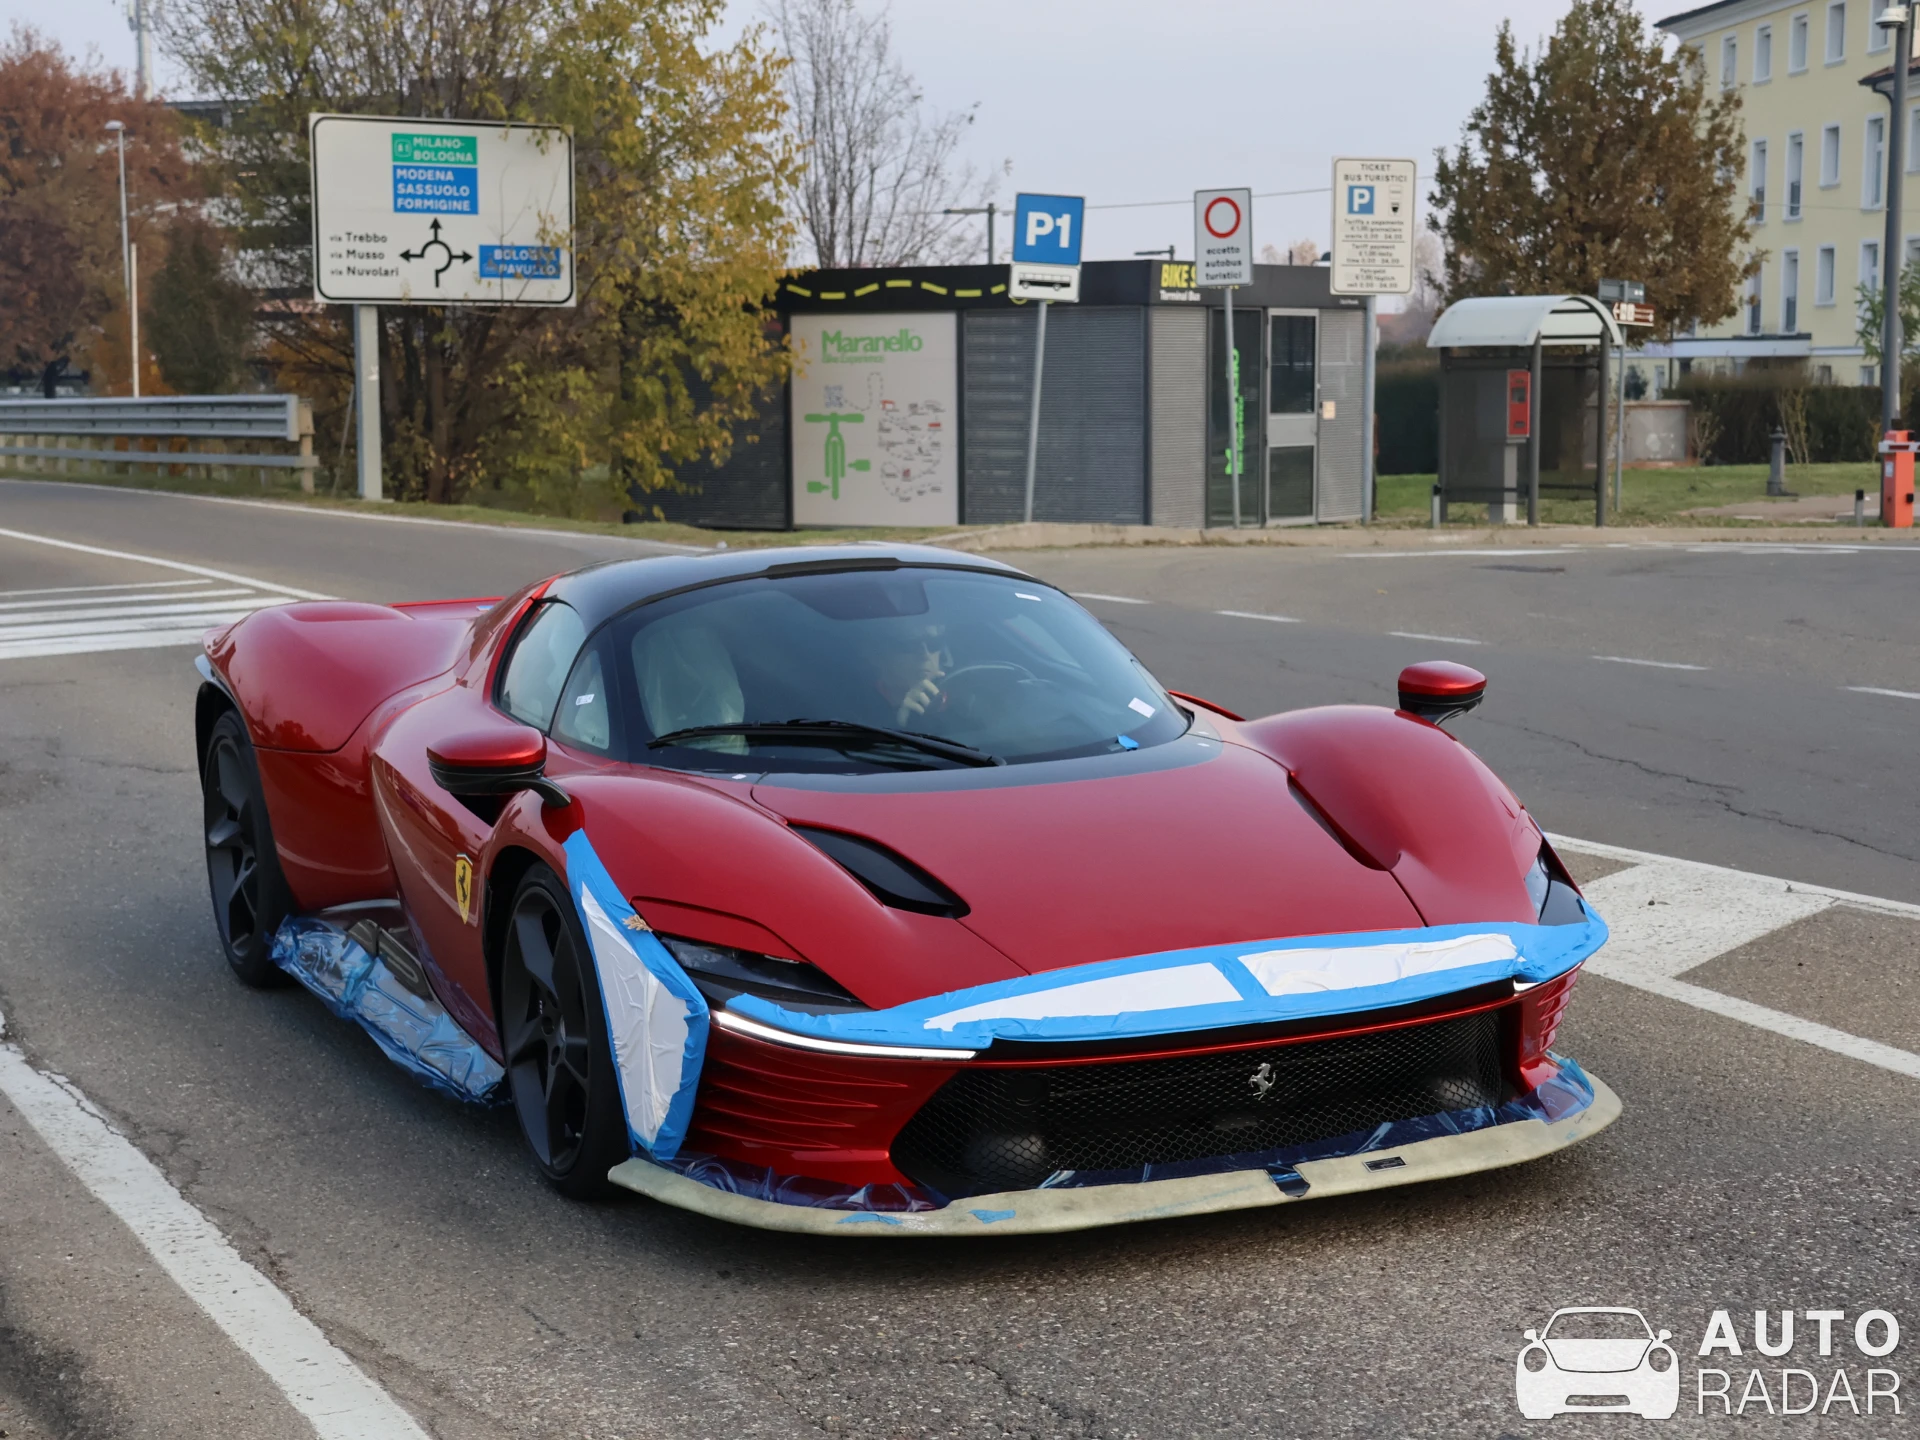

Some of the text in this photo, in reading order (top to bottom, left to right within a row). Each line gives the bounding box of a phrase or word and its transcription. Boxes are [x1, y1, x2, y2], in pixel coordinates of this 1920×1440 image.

[413, 150, 474, 162] BOLOGNA
[1361, 164, 1391, 172] TICKET
[396, 168, 454, 182] MODENA
[1343, 174, 1408, 183] BUS TURISTICI
[397, 183, 470, 197] SASSUOLO
[397, 198, 471, 212] FORMIGINE
[1353, 188, 1371, 212] P
[1026, 211, 1071, 248] P1
[346, 231, 388, 243] Trebbo
[346, 249, 385, 260] Musso
[494, 249, 558, 261] BOLOG
[1206, 246, 1241, 255] eccetto
[1205, 259, 1242, 268] autobus
[346, 266, 399, 277] Nuvolari
[1161, 264, 1189, 288] BIKE
[1205, 271, 1242, 280] turistici
[822, 328, 923, 352] Maranello
